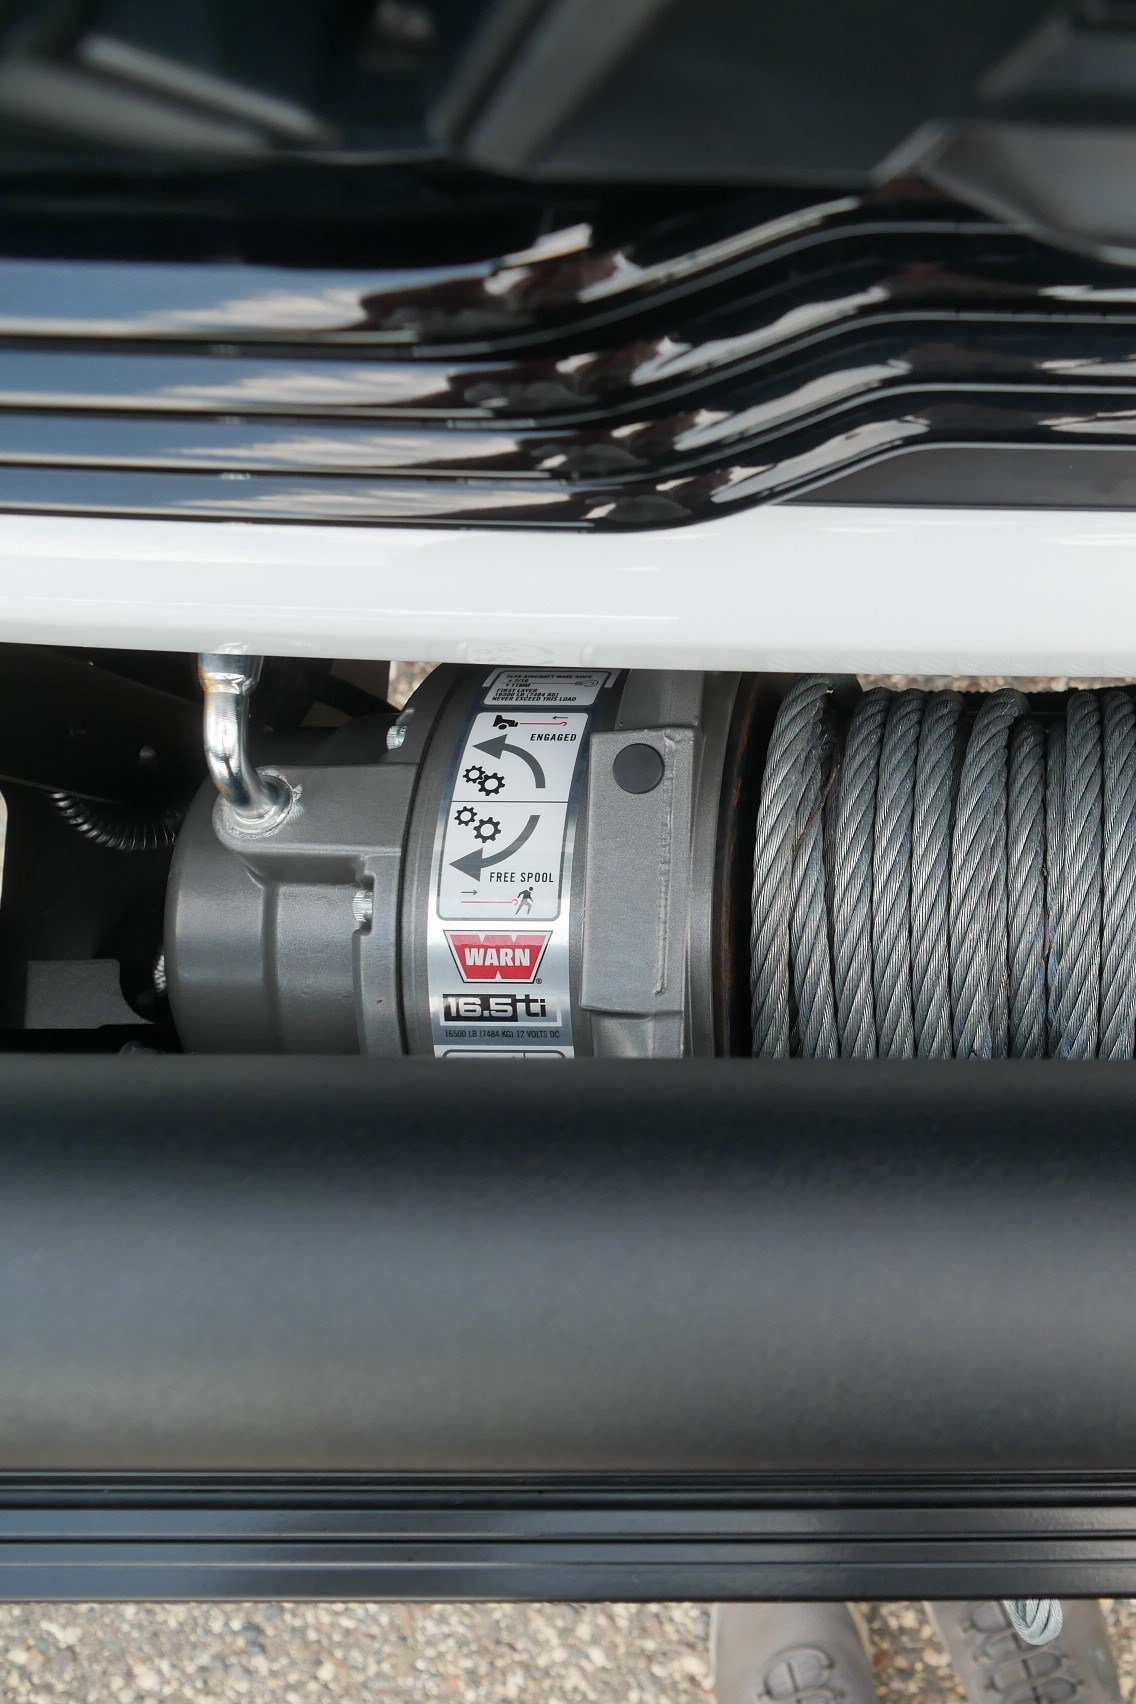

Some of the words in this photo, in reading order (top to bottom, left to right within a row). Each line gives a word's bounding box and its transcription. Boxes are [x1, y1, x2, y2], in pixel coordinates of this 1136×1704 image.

[530, 733, 577, 742] ENGAGED
[489, 872, 515, 883] FREE
[520, 872, 554, 883] SPOOL
[464, 947, 531, 967] WARN
[444, 1030, 466, 1038] 16500
[468, 1030, 478, 1038] LB
[479, 1030, 500, 1039] (7484
[502, 1030, 514, 1039] KG)
[516, 1030, 524, 1039] 12
[527, 1030, 548, 1039] VOLTS
[549, 1030, 560, 1039] DC
